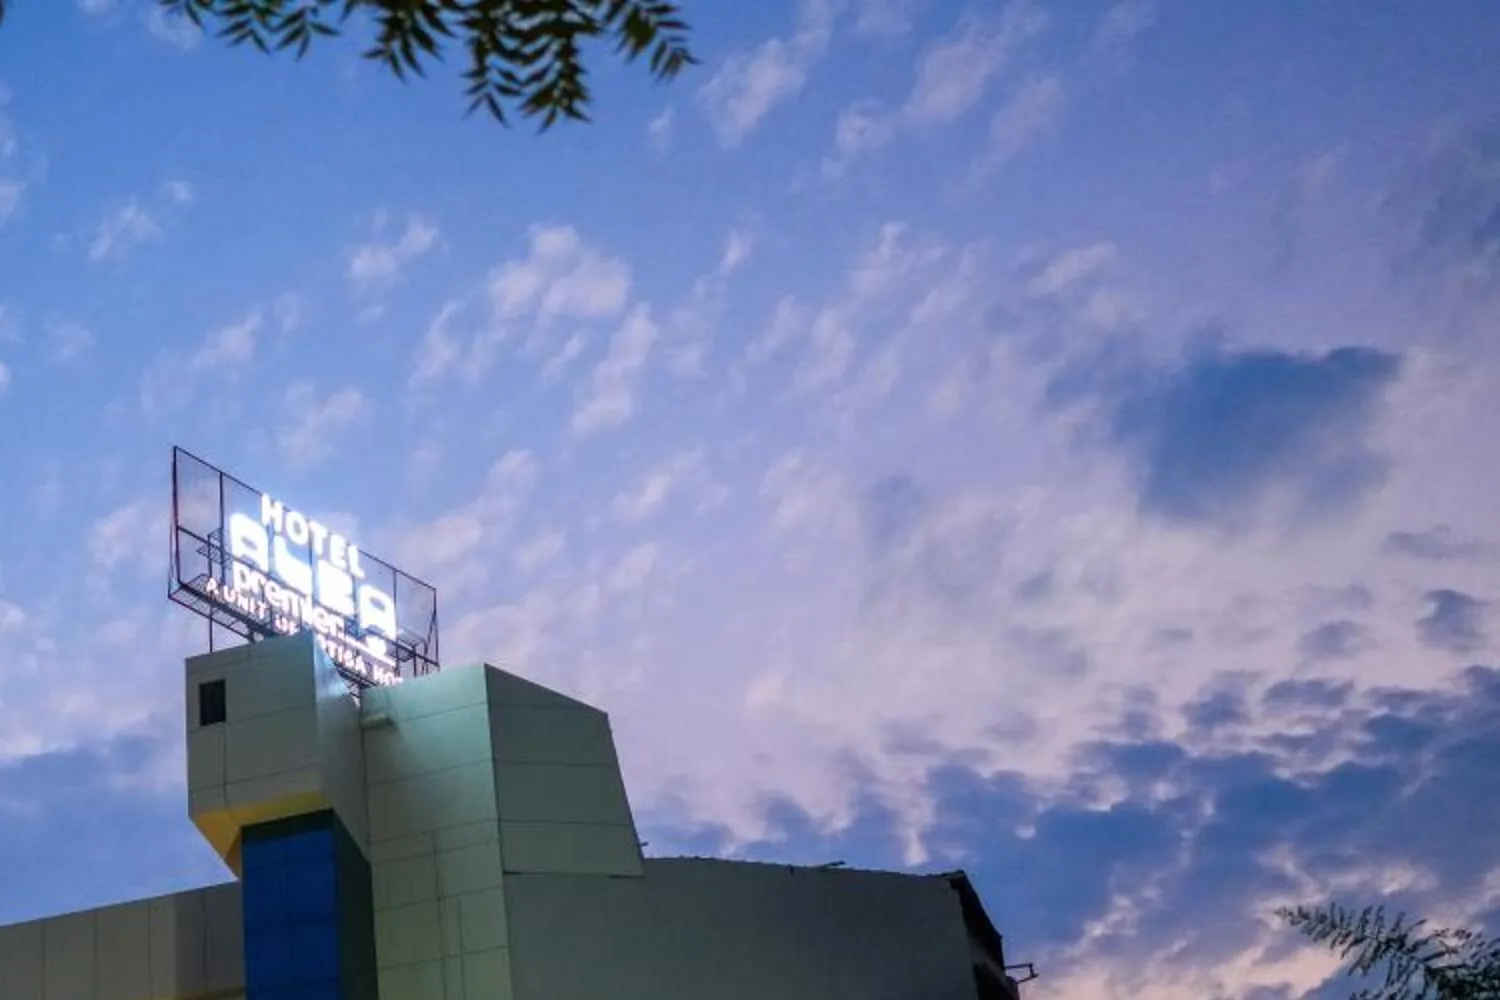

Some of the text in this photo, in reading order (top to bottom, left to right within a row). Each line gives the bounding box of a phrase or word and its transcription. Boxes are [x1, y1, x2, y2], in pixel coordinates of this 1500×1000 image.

[229, 512, 397, 643] ALBA
[261, 493, 365, 579] HOTEL
[206, 577, 220, 596] A
[223, 585, 267, 619] UNIT
[233, 562, 346, 643] premier
